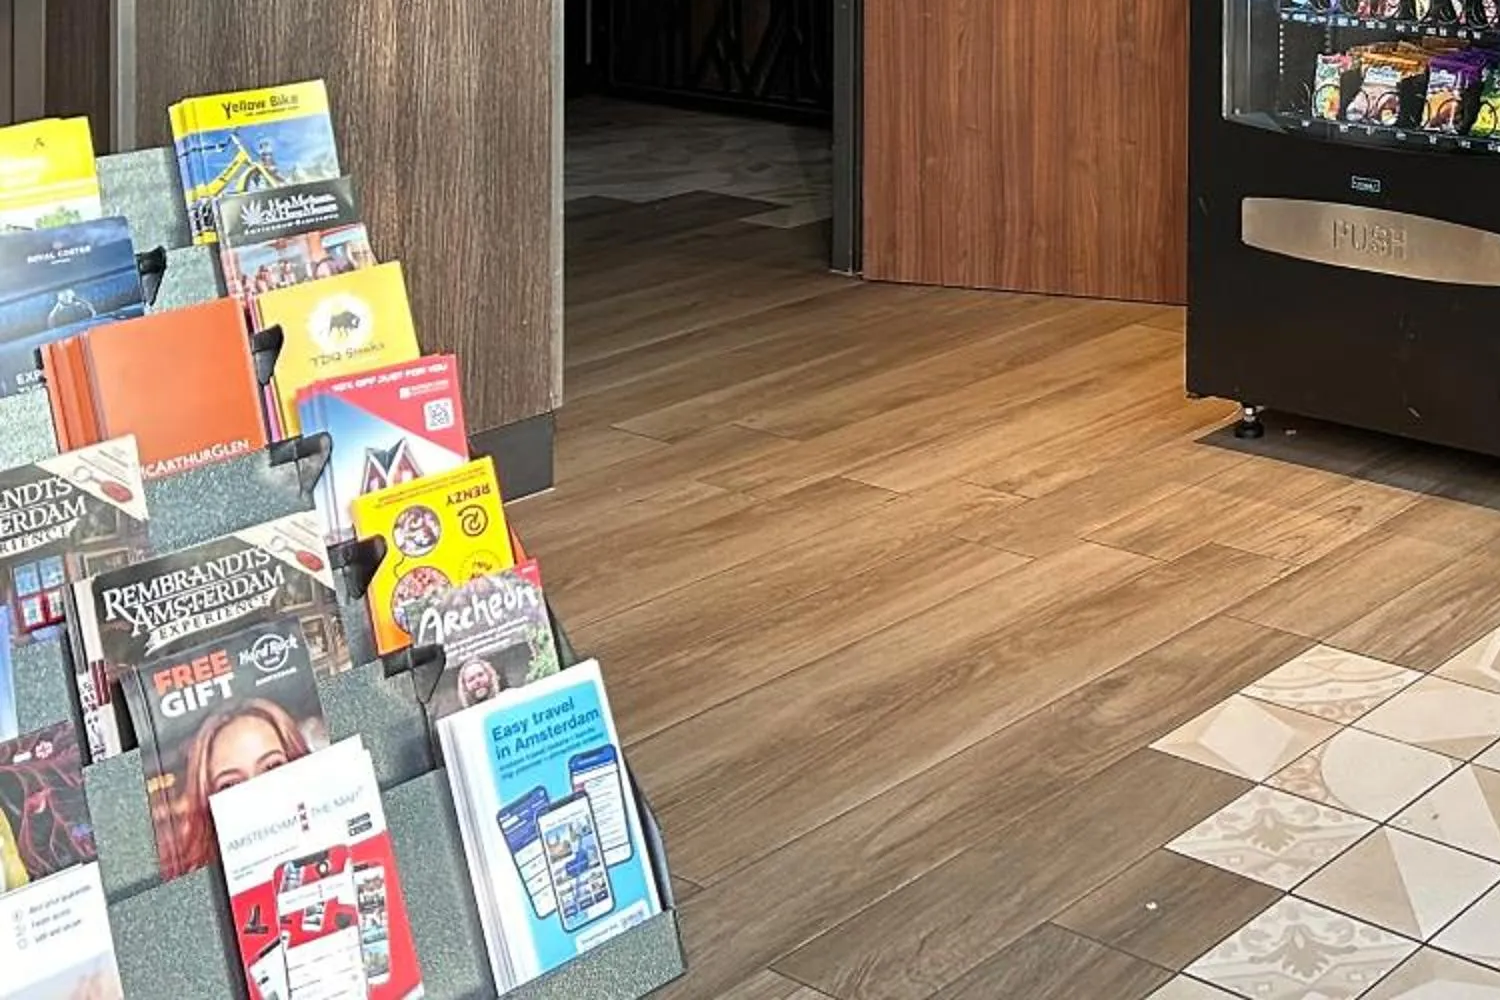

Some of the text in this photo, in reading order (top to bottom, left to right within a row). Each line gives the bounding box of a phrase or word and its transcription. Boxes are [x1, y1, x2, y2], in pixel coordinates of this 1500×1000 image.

[221, 98, 266, 119] Yellow
[1332, 219, 1407, 261] PUSH
[103, 547, 271, 621] REMBRANDTS
[131, 565, 285, 637] AMSTERDAM
[160, 593, 271, 640] EXPERIENCE
[153, 649, 232, 695] FREE
[160, 672, 235, 718] GIFT
[491, 695, 576, 742] Easy travel
[495, 744, 512, 761] in
[515, 708, 600, 752] Amsterdam
